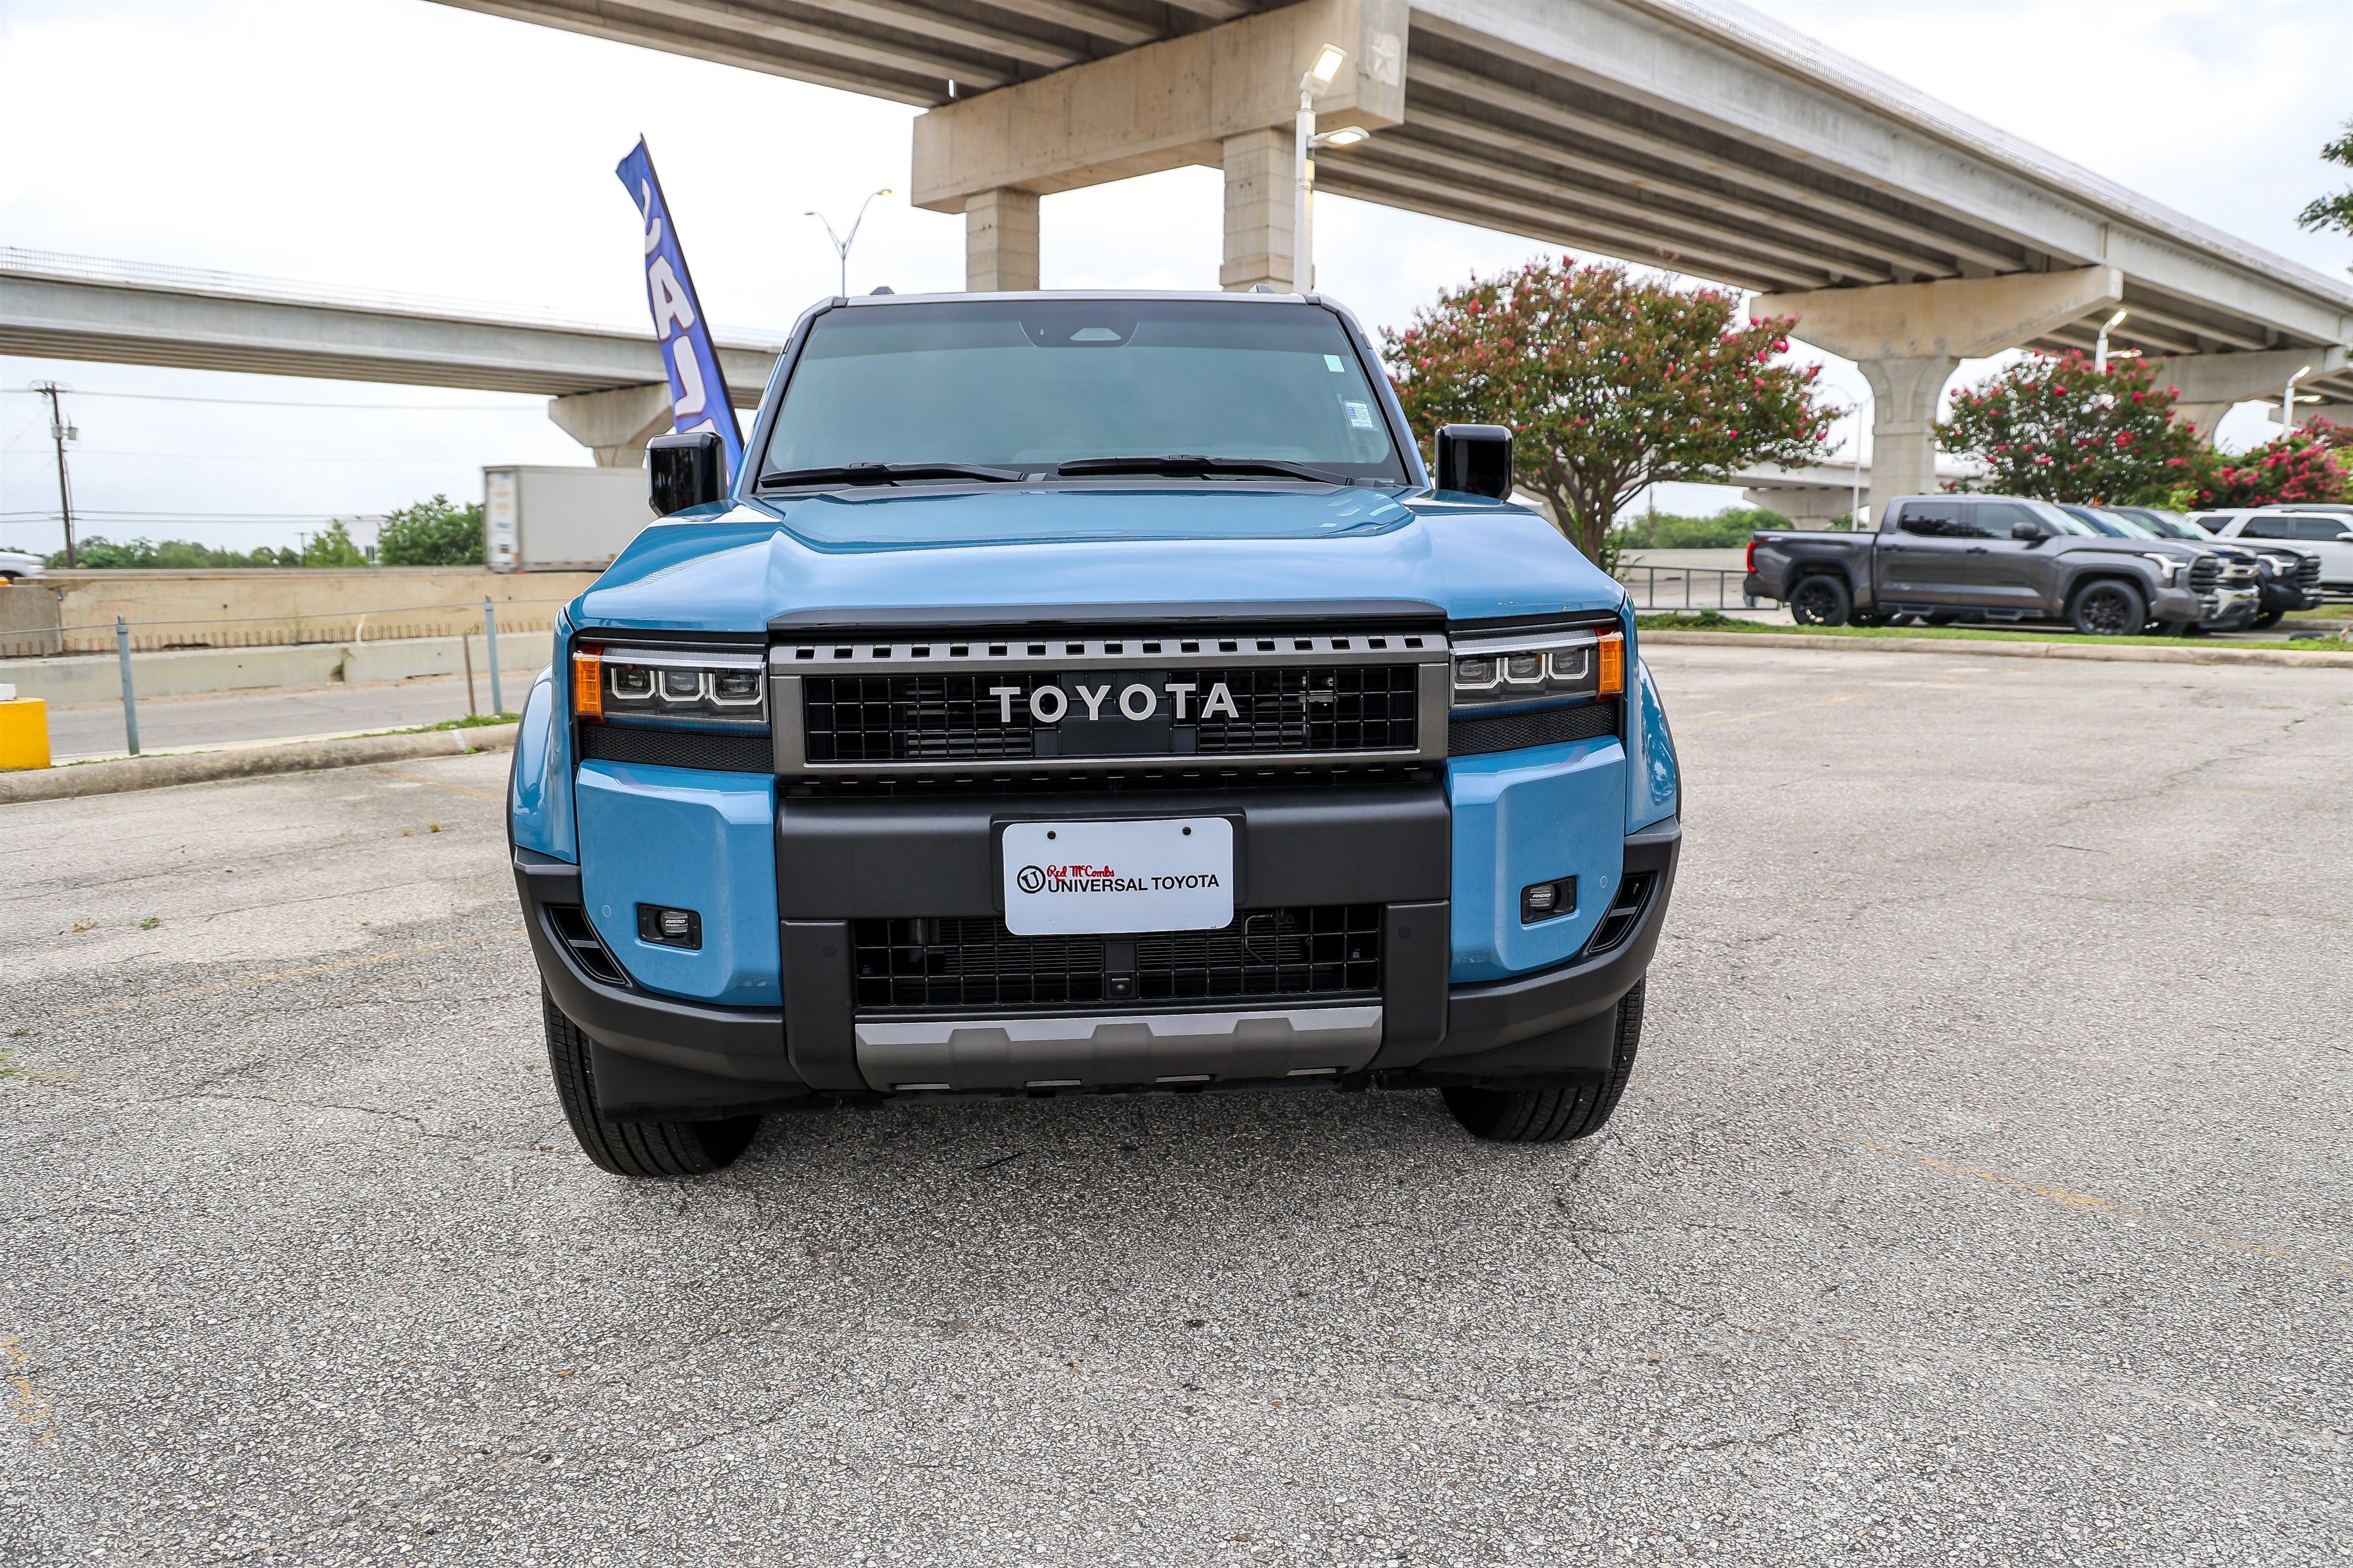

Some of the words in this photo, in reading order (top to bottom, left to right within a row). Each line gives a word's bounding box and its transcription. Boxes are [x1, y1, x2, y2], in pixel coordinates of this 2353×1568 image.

[989, 683, 1239, 723] TOYOTA
[1046, 864, 1067, 882] Red
[1069, 864, 1115, 878] McCombs
[1048, 878, 1148, 893] UNIVERSAL
[1151, 874, 1220, 890] TOYOTA
